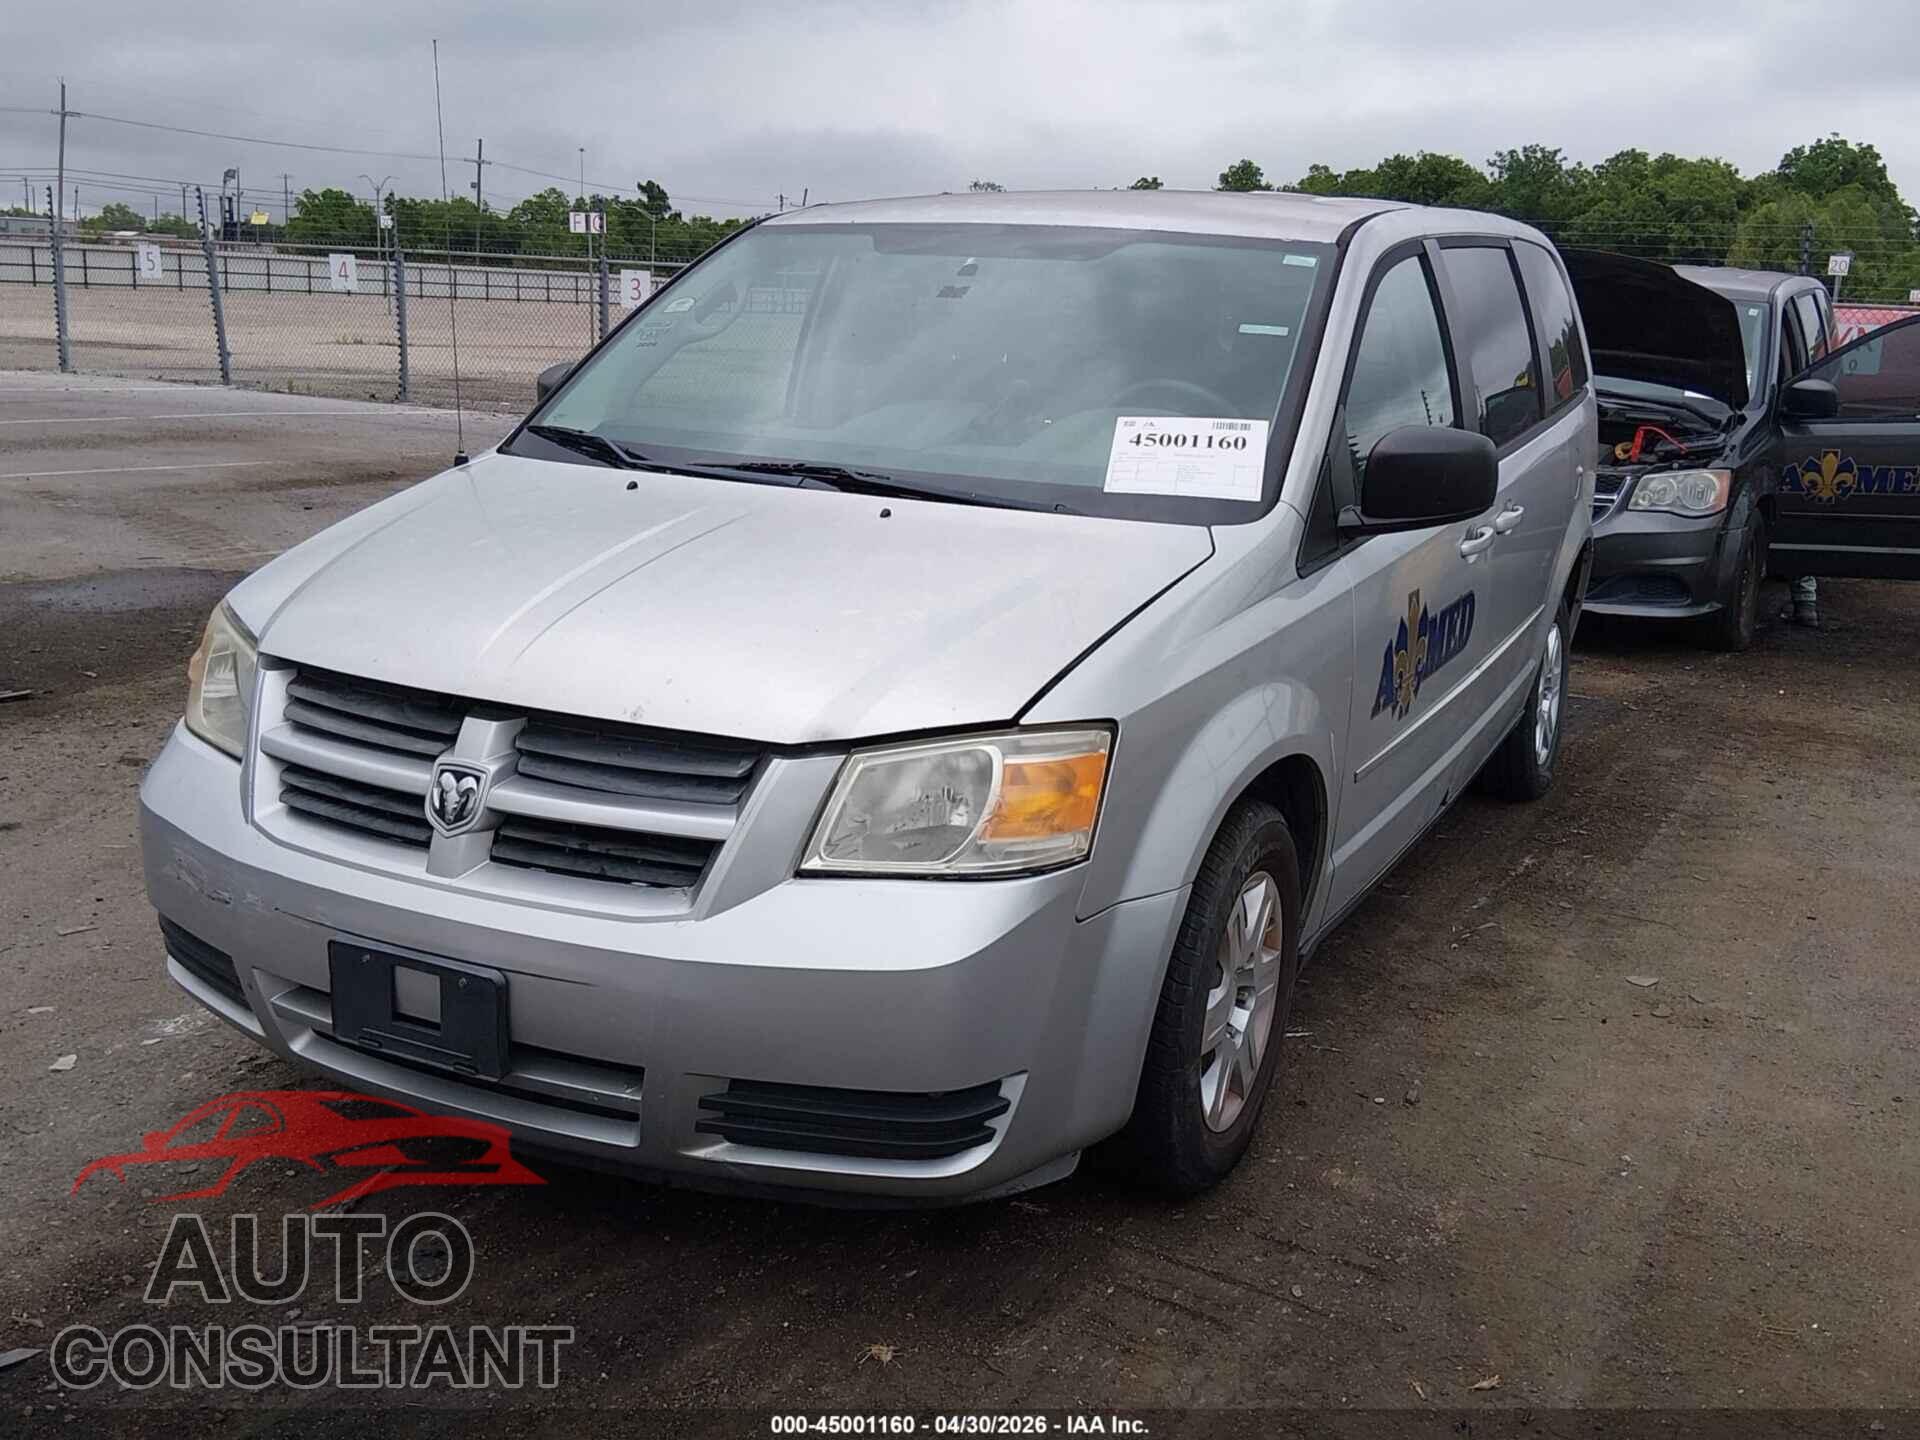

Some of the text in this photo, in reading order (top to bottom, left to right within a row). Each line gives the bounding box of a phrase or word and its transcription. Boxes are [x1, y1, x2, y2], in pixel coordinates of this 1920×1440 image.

[573, 213, 582, 231] F
[146, 251, 155, 271] 5
[1831, 260, 1848, 272] 20
[338, 261, 350, 282] 4
[630, 278, 642, 301] 3
[1128, 432, 1248, 451] 45001160
